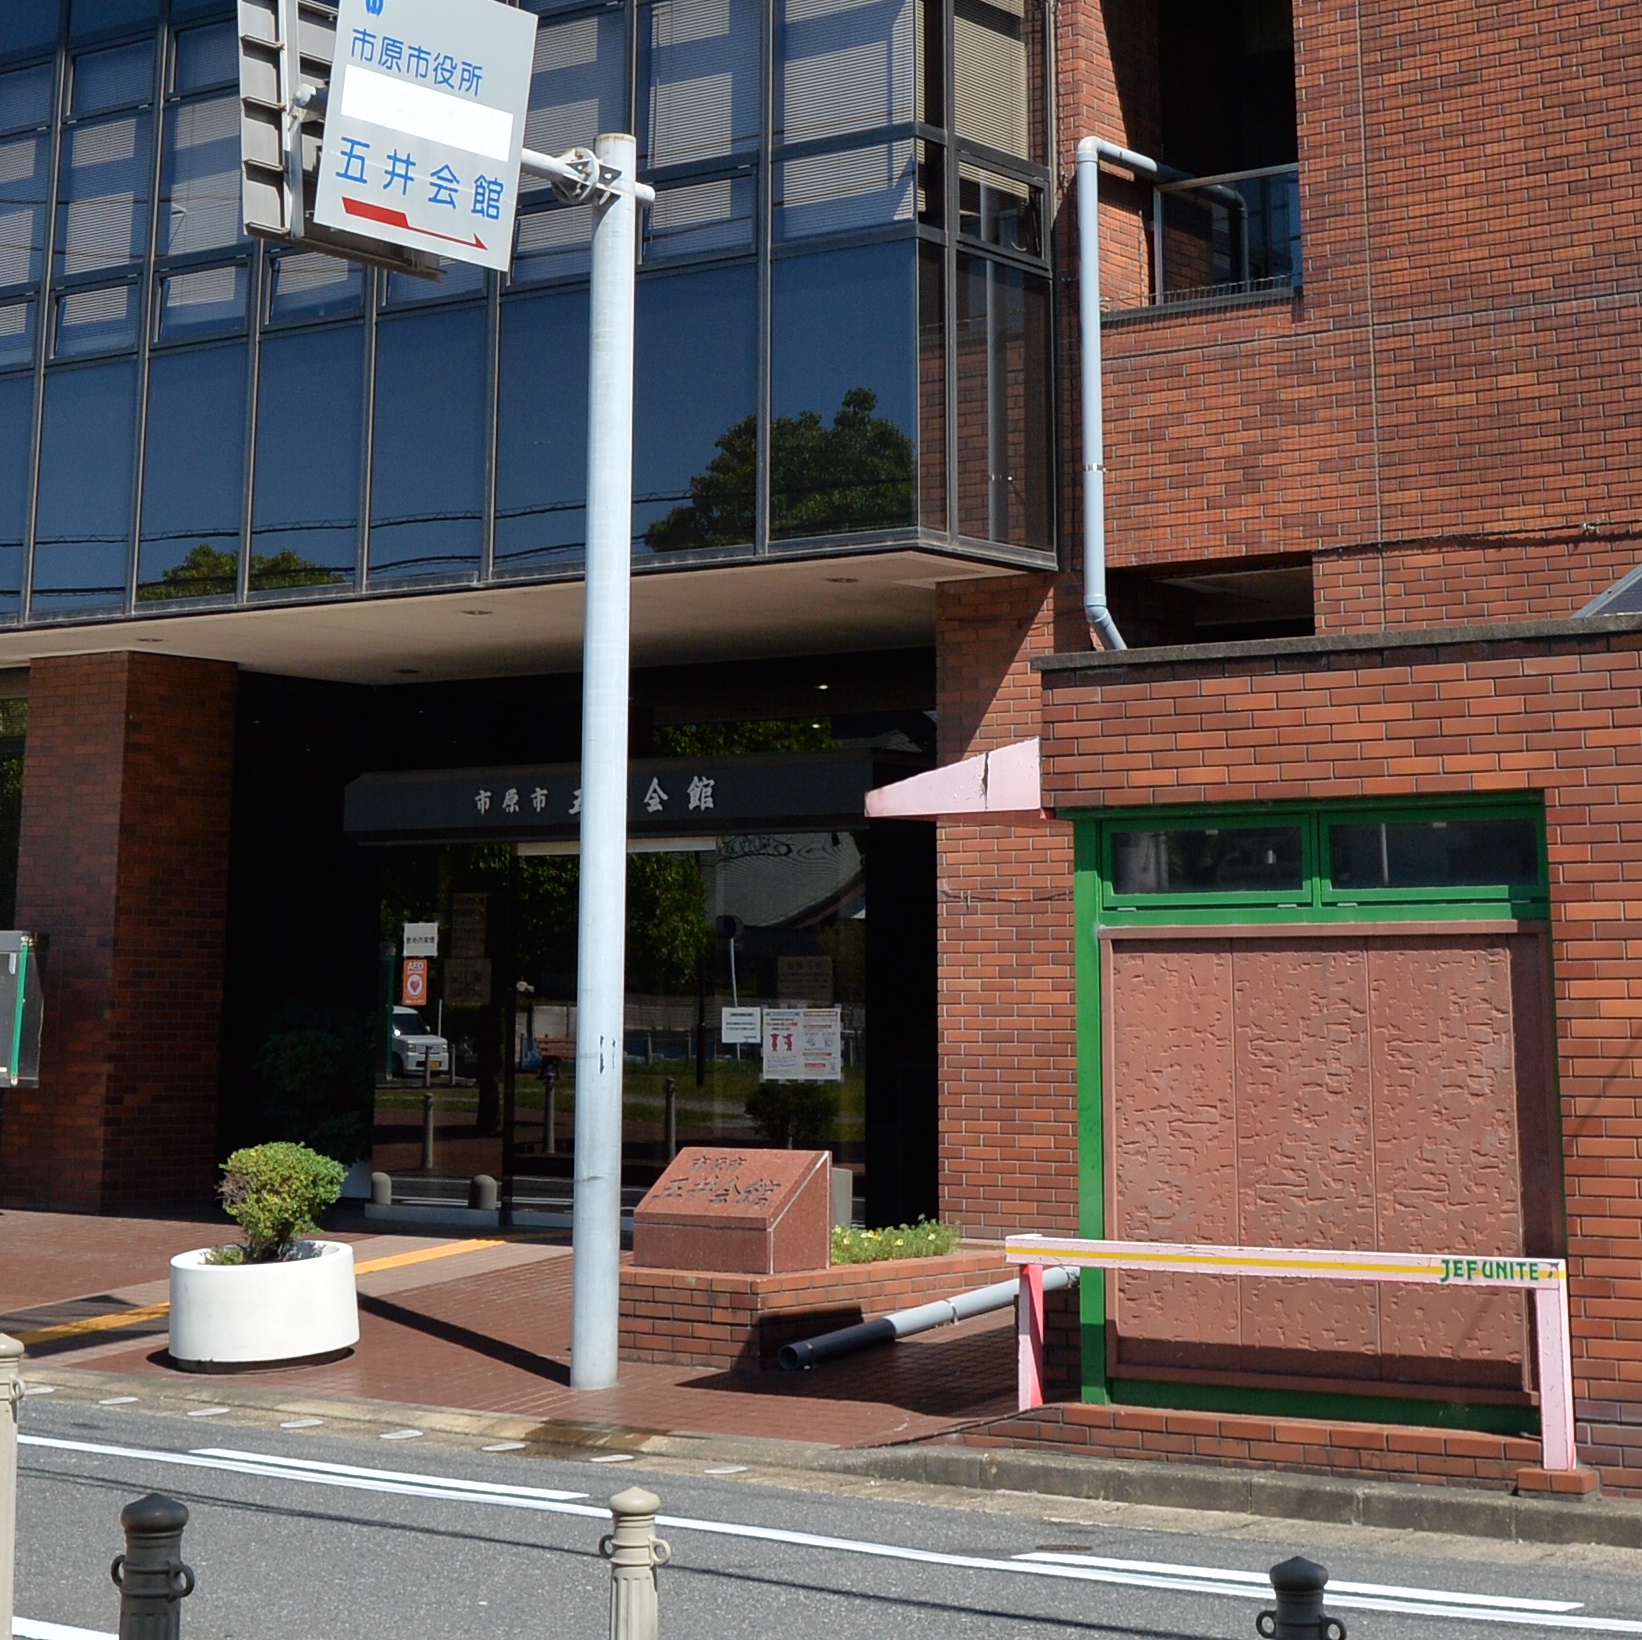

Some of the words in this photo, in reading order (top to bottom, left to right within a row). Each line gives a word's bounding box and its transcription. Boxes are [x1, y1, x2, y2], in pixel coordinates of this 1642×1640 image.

[351, 28, 484, 97] 市原市役所
[336, 136, 504, 221] 五井会館
[474, 787, 548, 814] 市原市
[1440, 1260, 1477, 1282] JEF
[1482, 1261, 1553, 1280] UNITE
